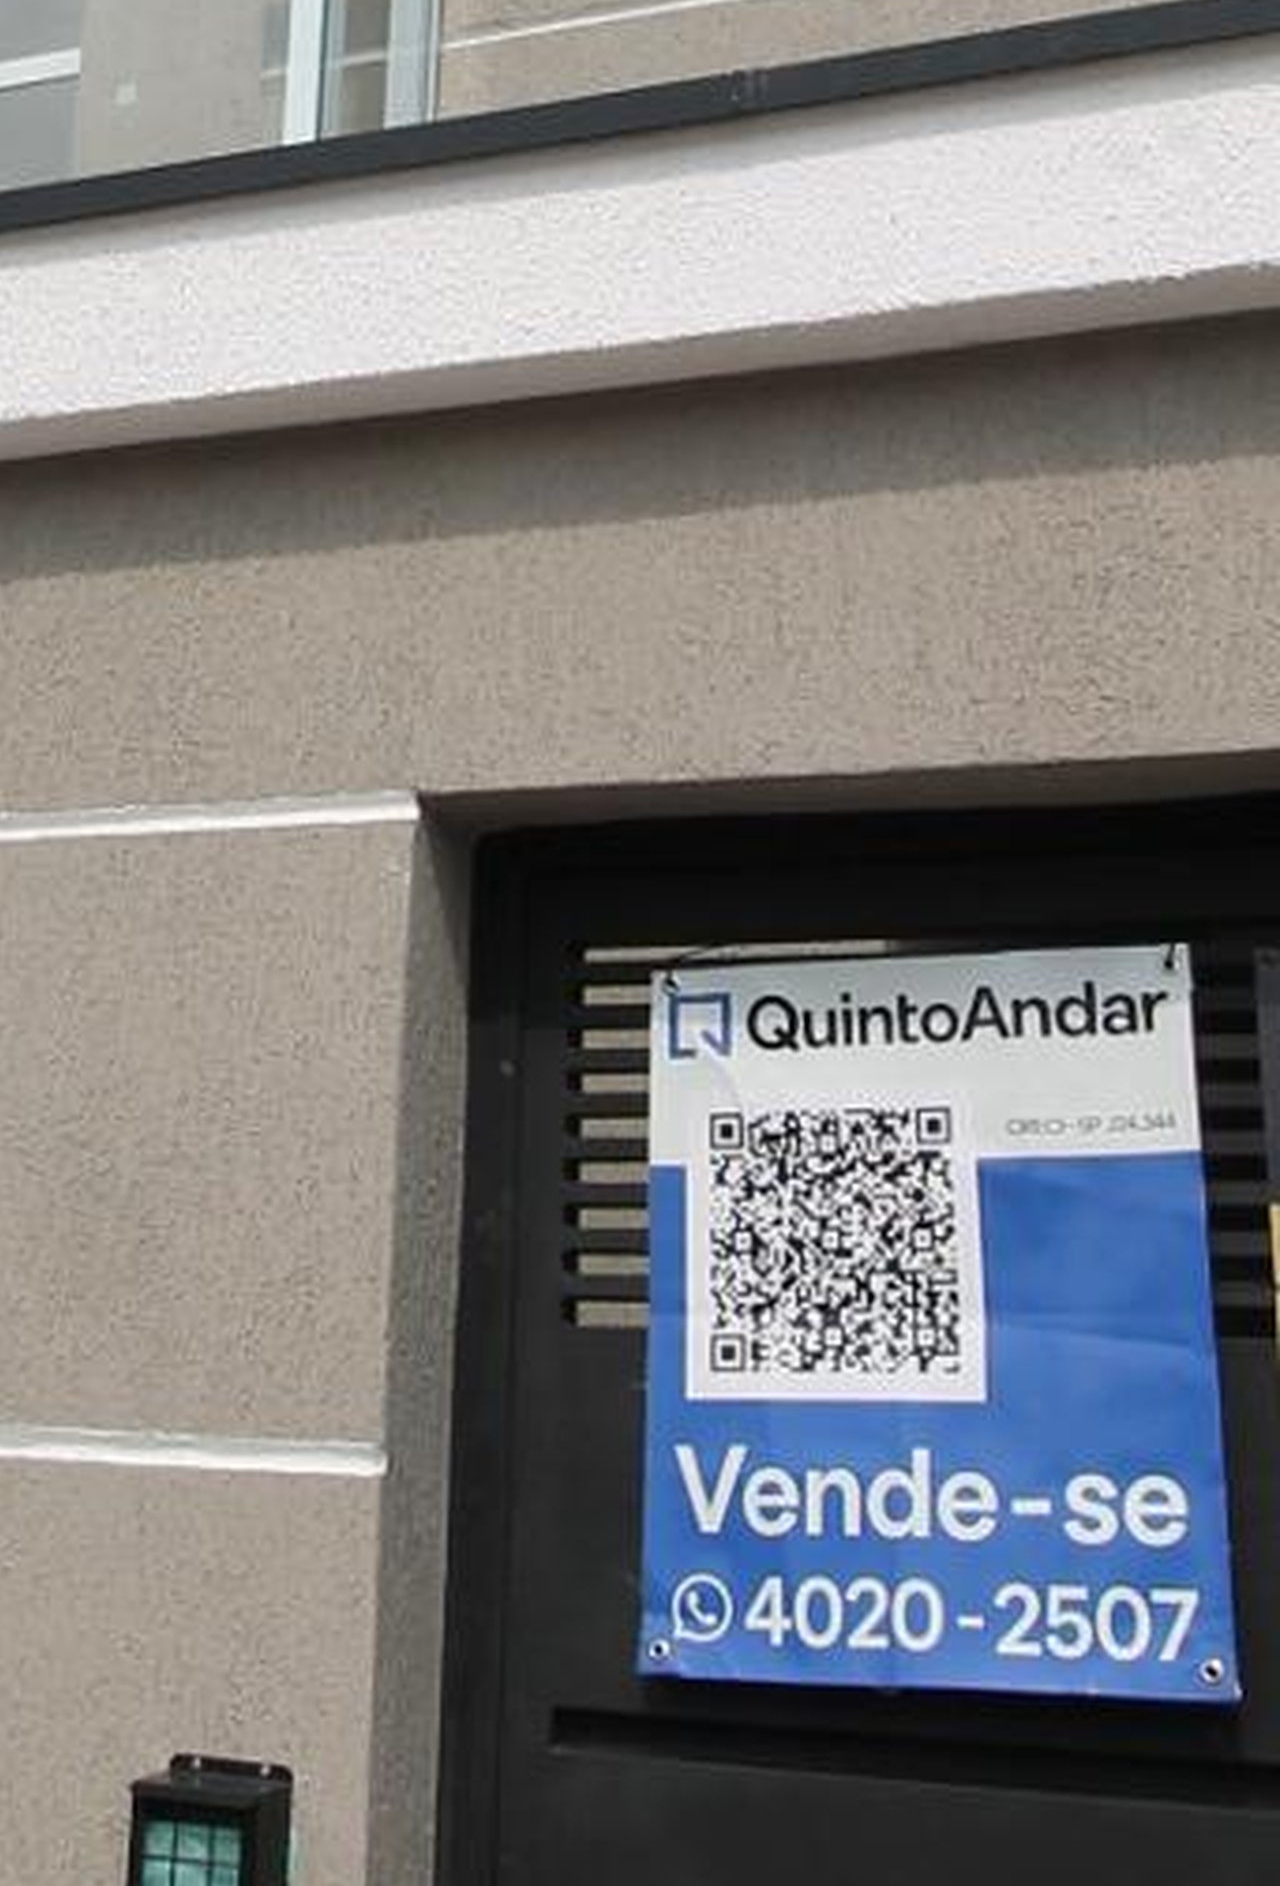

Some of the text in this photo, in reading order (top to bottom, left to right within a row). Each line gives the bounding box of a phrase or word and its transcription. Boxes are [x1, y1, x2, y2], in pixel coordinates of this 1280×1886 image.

[747, 982, 1168, 1053] QuintoAndar
[674, 1443, 1189, 1547] Vende-se
[743, 1574, 1200, 1662] 4020-2507
